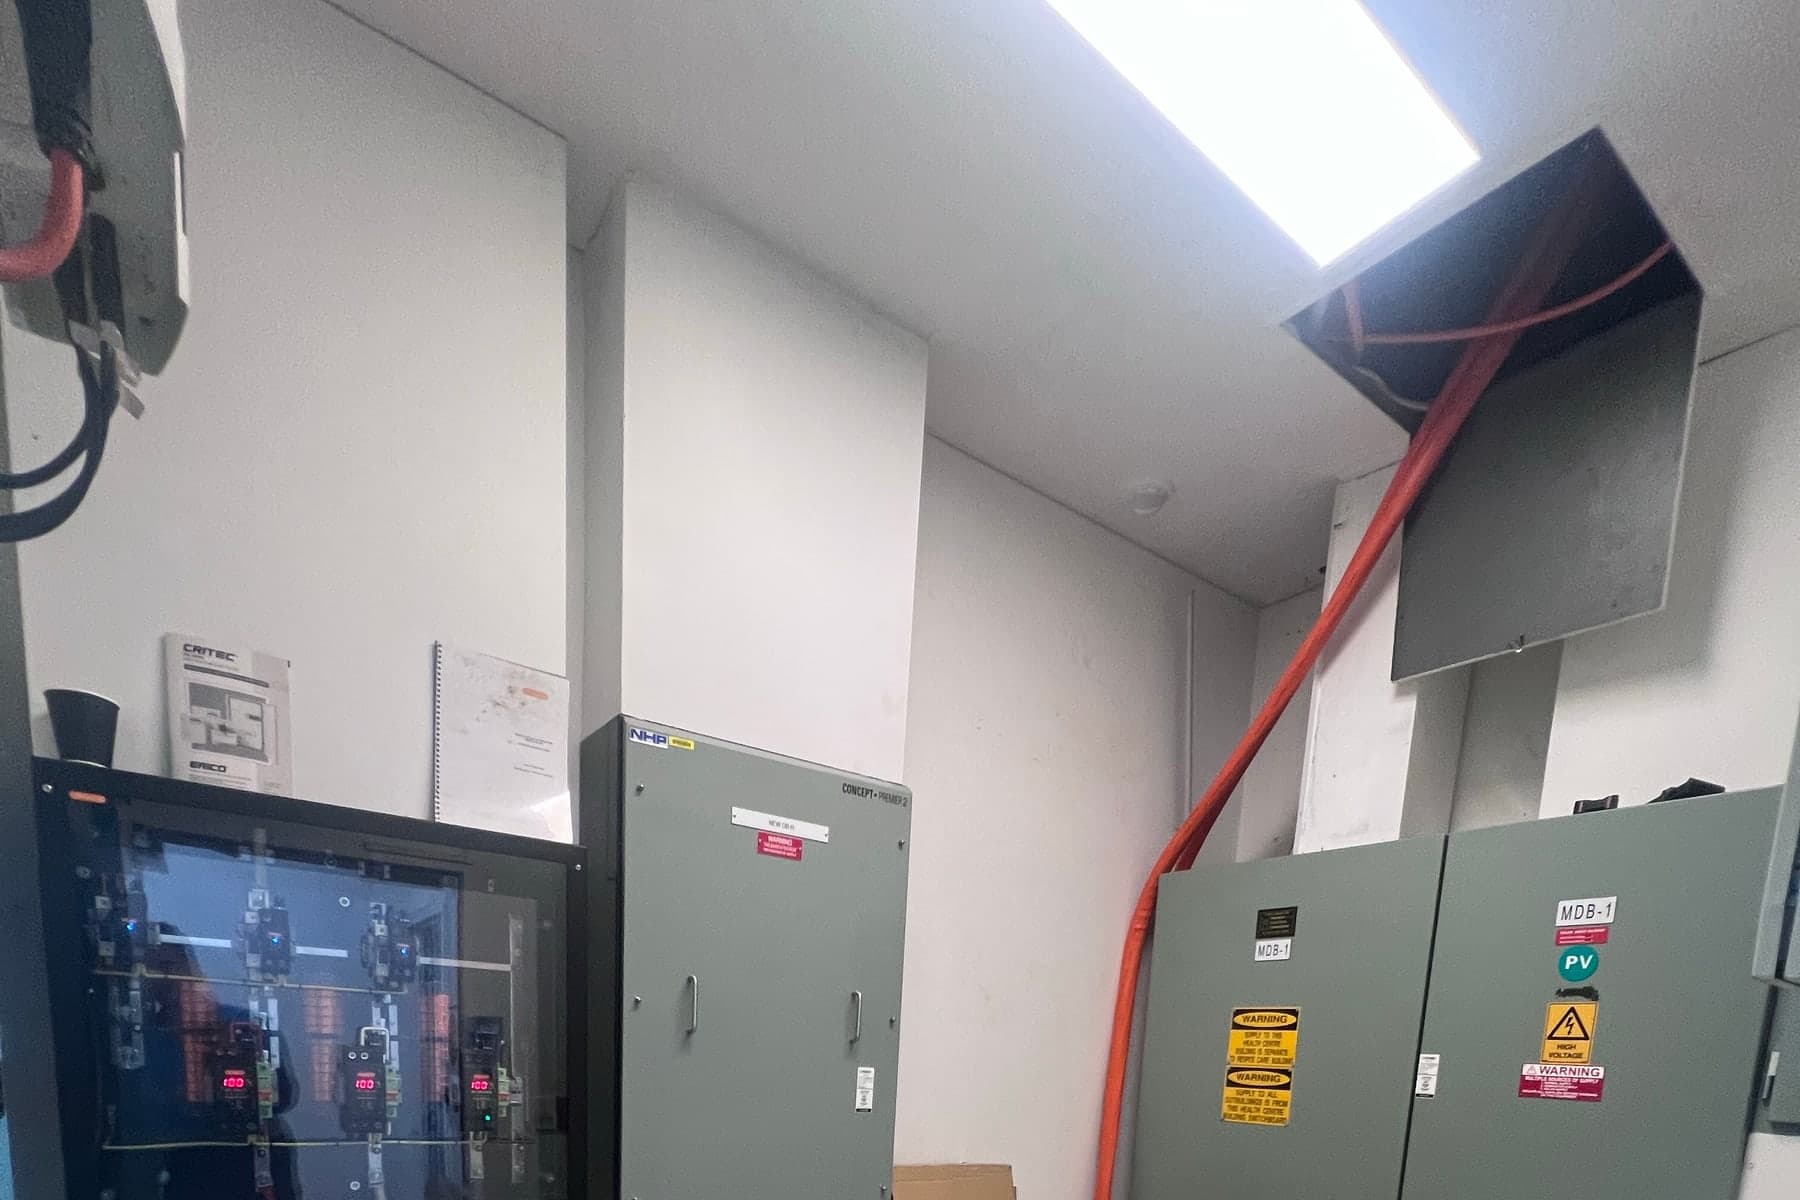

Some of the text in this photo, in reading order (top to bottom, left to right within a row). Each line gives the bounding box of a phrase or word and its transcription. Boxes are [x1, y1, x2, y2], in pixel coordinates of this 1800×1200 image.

[183, 643, 236, 662] CRITEC
[630, 728, 667, 745] NHP
[190, 761, 226, 773] ERICO
[842, 783, 873, 799] CONCEPT
[1561, 902, 1612, 920] MDB-1
[1258, 944, 1289, 957] MDB-1
[1565, 954, 1593, 969] PV
[1242, 1015, 1288, 1023] WARNING
[1236, 1073, 1281, 1082] WARNING
[1540, 1066, 1600, 1077] WARNING
[223, 1078, 245, 1088] 100
[355, 1080, 375, 1089] 100
[471, 1081, 488, 1090] 100
